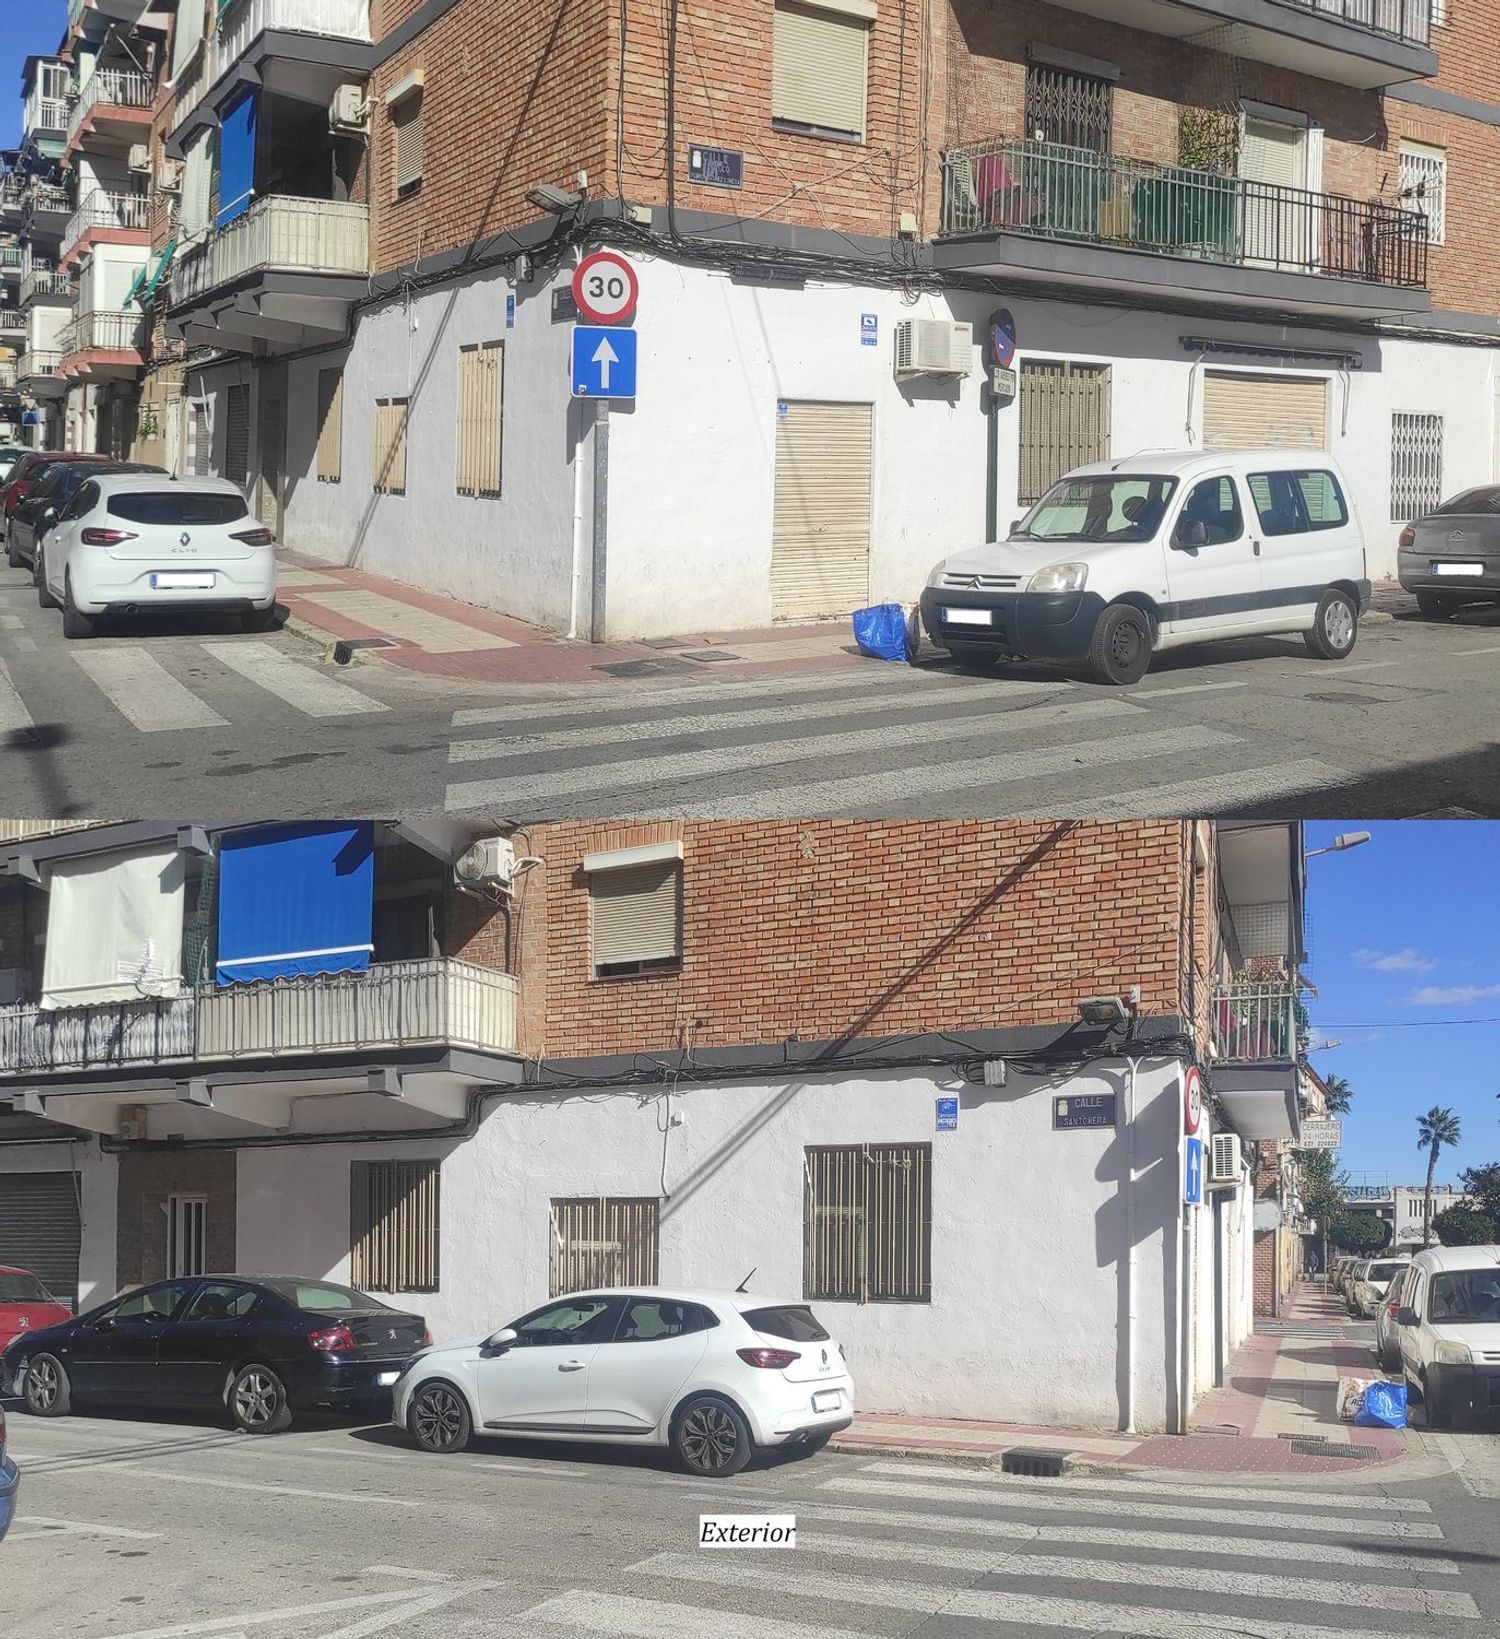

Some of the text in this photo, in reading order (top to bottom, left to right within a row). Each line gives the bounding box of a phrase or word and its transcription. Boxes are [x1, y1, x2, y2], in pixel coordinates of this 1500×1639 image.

[589, 276, 624, 299] 30
[1074, 1096, 1103, 1108] CALLE
[1063, 1116, 1107, 1127] SANTOMERA
